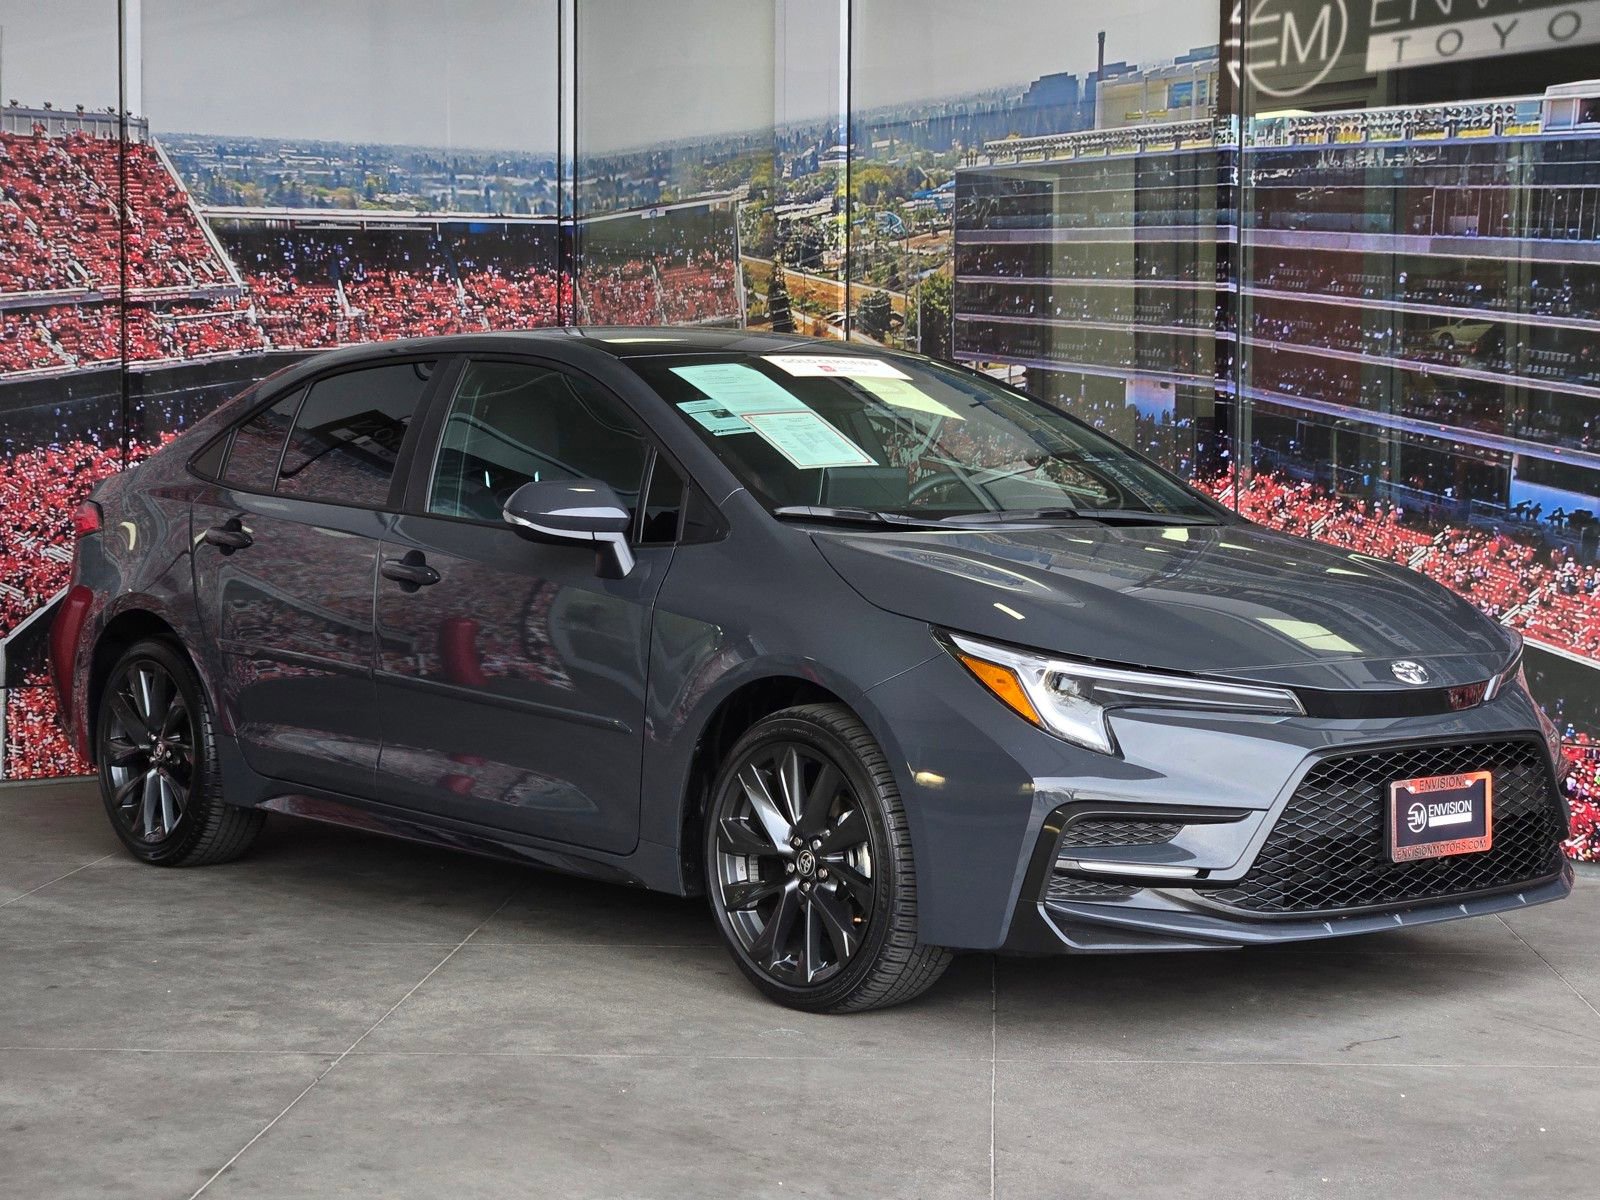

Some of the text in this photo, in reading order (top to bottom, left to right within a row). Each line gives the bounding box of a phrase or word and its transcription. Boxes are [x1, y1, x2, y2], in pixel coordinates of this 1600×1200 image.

[1392, 10, 1582, 63] TOYO
[1419, 776, 1462, 791] ENVISION
[1429, 799, 1472, 817] ENVISION
[1397, 840, 1486, 860] ENVISIONMOTORS.COM
